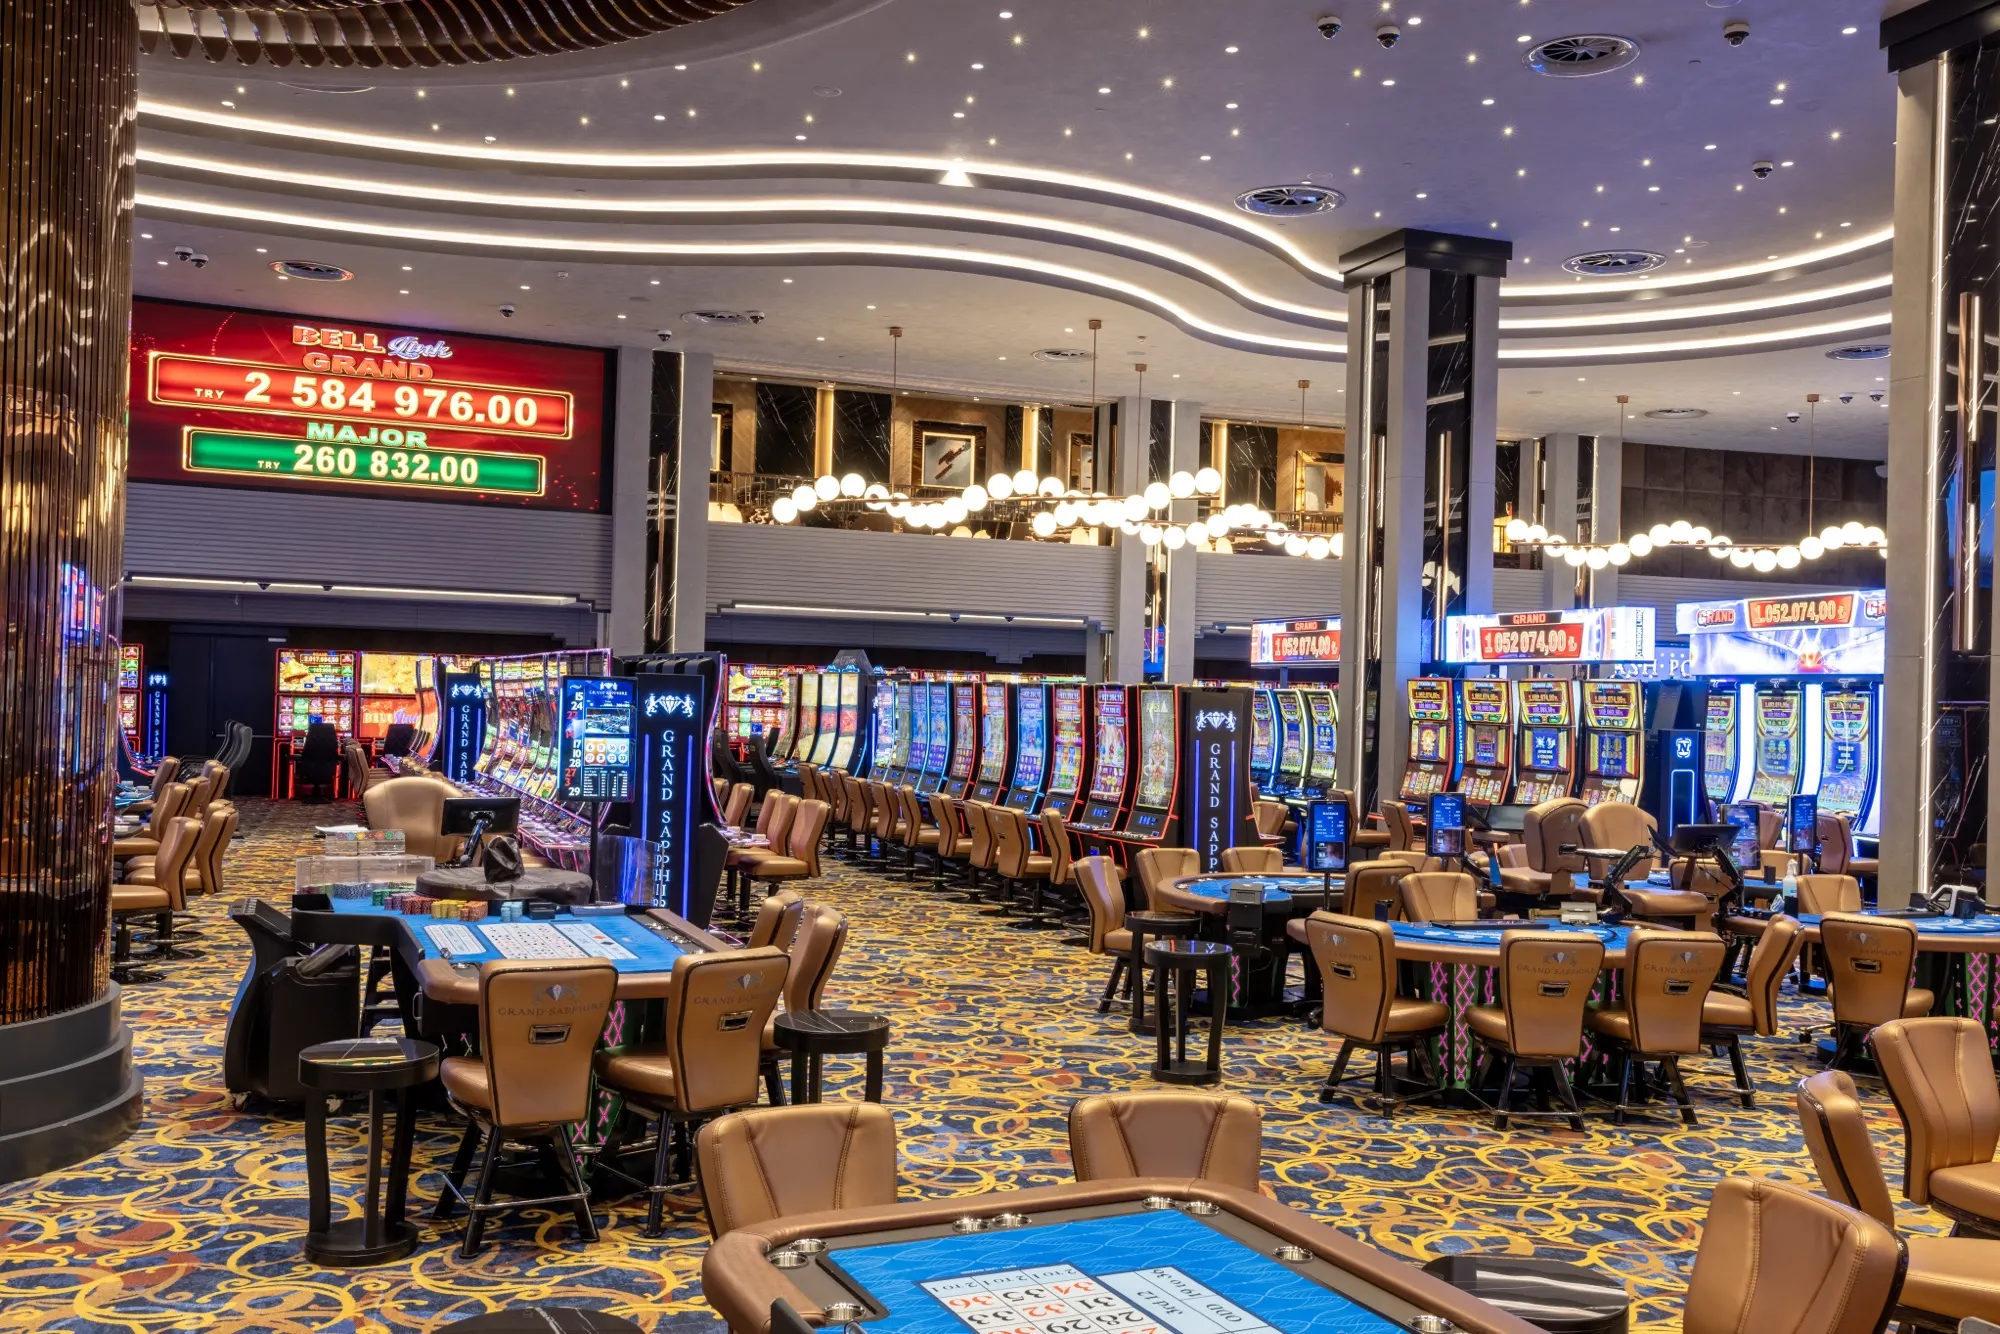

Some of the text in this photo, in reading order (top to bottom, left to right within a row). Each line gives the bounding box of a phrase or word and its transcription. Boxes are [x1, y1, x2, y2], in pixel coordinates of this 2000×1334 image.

[293, 326, 453, 359] BELL Link
[302, 352, 433, 381] GRAND
[195, 372, 537, 427] TRY 2 584 976.00
[307, 422, 428, 449] MAJOR
[258, 444, 478, 485] TRY 260 832.00
[1513, 613, 1545, 624] GRAND
[1697, 609, 1735, 626] GRAND
[1295, 622, 1318, 631] GRAND
[575, 692, 583, 700] 15
[571, 702, 583, 710] 24
[567, 711, 578, 720] 27
[461, 705, 470, 747] GRAND
[573, 739, 581, 748] 17
[573, 749, 581, 757] 10
[569, 759, 581, 767] 28
[662, 730, 675, 800] GRAND
[565, 768, 576, 777] 27
[564, 778, 571, 787] 3
[568, 787, 580, 796] 29
[1209, 744, 1221, 873] GRAND SAPP
[1517, 964, 1550, 974] GRAND
[1644, 964, 1677, 974] GRAND
[693, 996, 733, 1005] GRAND
[497, 1000, 604, 1016] GRAND SAPPHIRE
[1154, 1269, 1172, 1279] 36
[1052, 1280, 1096, 1294] 34
[1180, 1288, 1202, 1297] 19
[949, 1295, 992, 1309] 36
[1003, 1288, 1047, 1302] 35
[1078, 1296, 1117, 1309] 31
[1152, 1299, 1184, 1316] 3rd
[1023, 1303, 1066, 1318] 32
[1206, 1303, 1242, 1323] ODD
[968, 1311, 1014, 1325] 33
[1096, 1311, 1144, 1326] 28
[1046, 1318, 1092, 1334] 29
